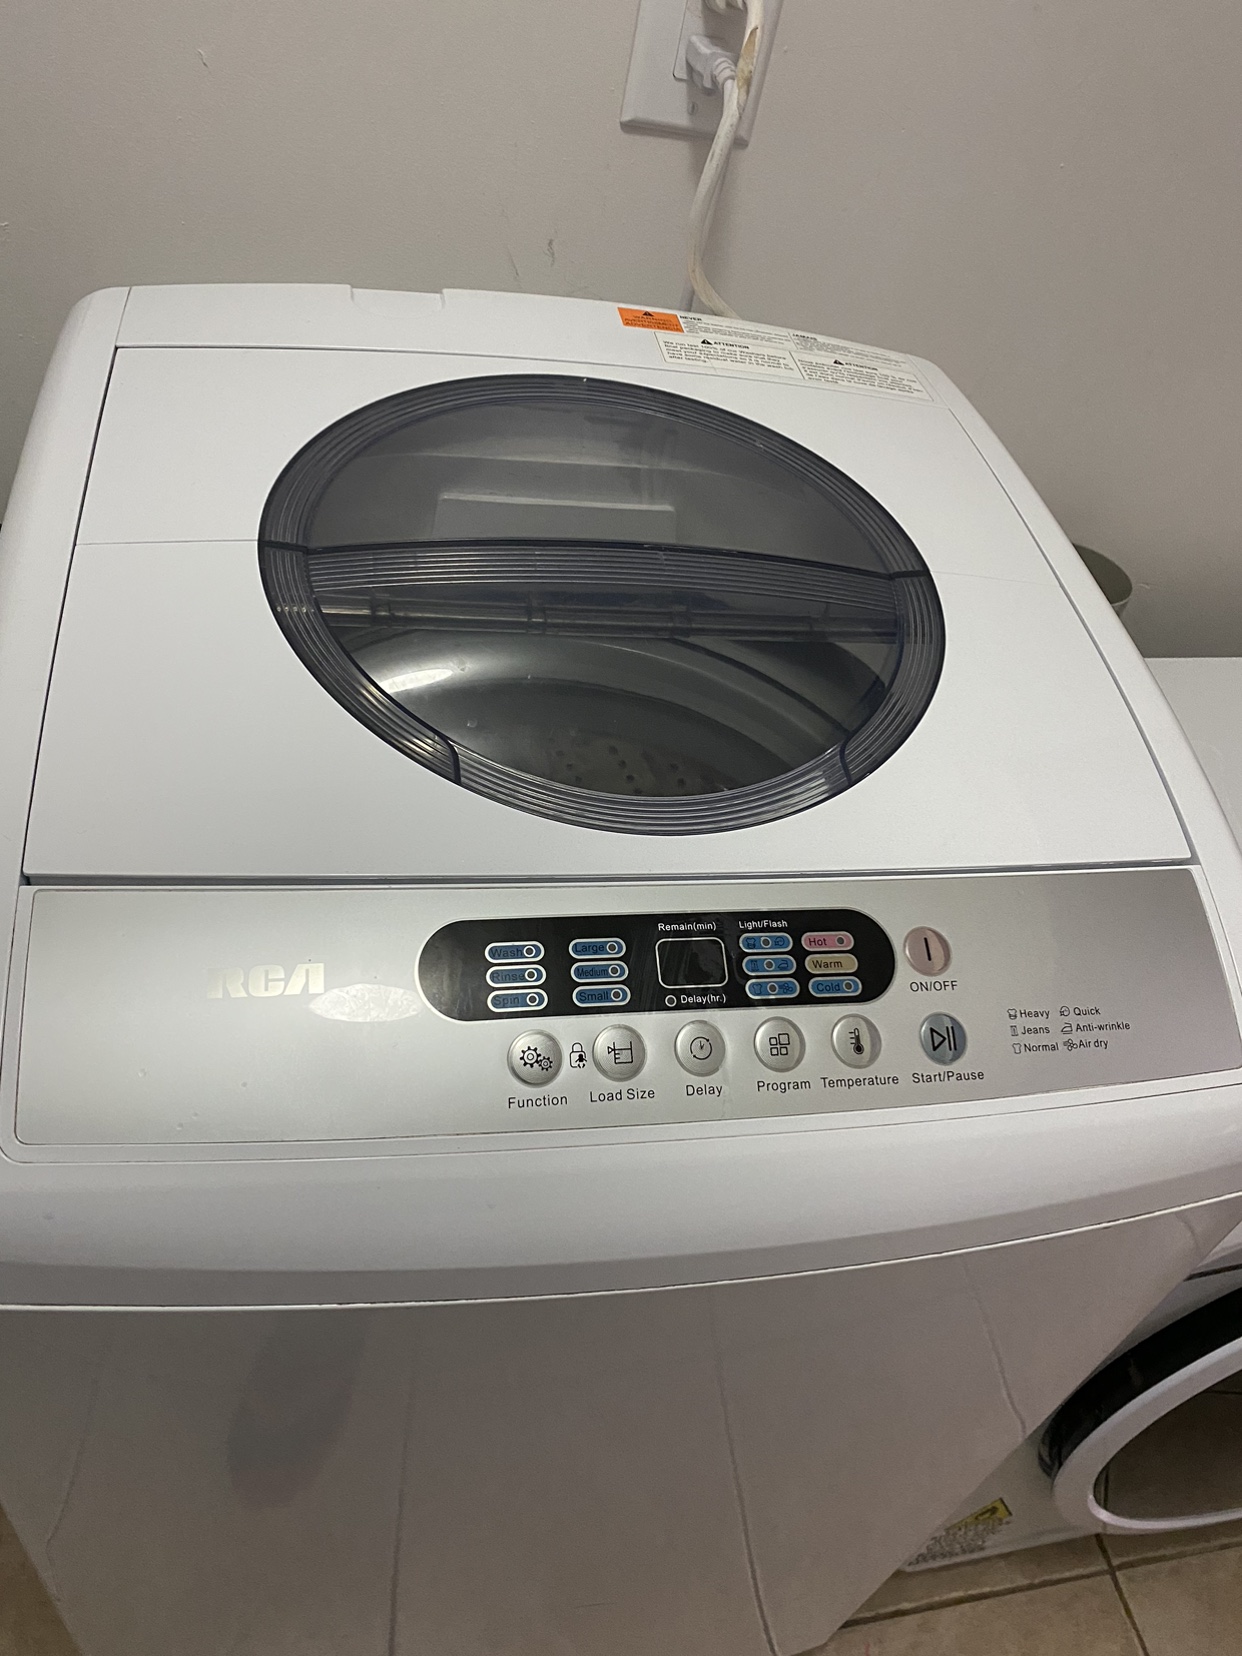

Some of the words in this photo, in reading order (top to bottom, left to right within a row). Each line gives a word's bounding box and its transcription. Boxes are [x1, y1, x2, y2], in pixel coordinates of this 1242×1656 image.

[714, 341, 750, 349] ATTENTION
[658, 921, 717, 931] Remain(min)
[738, 920, 788, 930] Light/Flash
[808, 937, 828, 946] Hot
[490, 948, 523, 959] Wash
[574, 943, 605, 954] Large
[812, 959, 843, 969] Warm
[491, 971, 525, 982] Rinse
[576, 967, 609, 977] Medium
[206, 962, 325, 999] RCA
[909, 980, 958, 992] ON/OFF
[816, 982, 840, 992] Cold
[493, 995, 520, 1006] Spin
[579, 991, 609, 1001] Small
[680, 994, 726, 1004] Delay(hr.)
[1019, 1009, 1050, 1020] Heavy
[1073, 1006, 1101, 1017] Quick
[1021, 1026, 1050, 1035] Jeans
[1075, 1021, 1131, 1033] Anti-wrinkle
[1023, 1041, 1059, 1052] Normal
[1078, 1039, 1091, 1049] Air
[1094, 1038, 1109, 1049] dry
[820, 1073, 900, 1089] Temperature
[911, 1069, 985, 1084] Start/Pause
[685, 1083, 723, 1098] Delay
[756, 1078, 811, 1094] Program
[589, 1088, 623, 1103] Load
[626, 1087, 656, 1101] Size
[507, 1094, 568, 1109] Function
